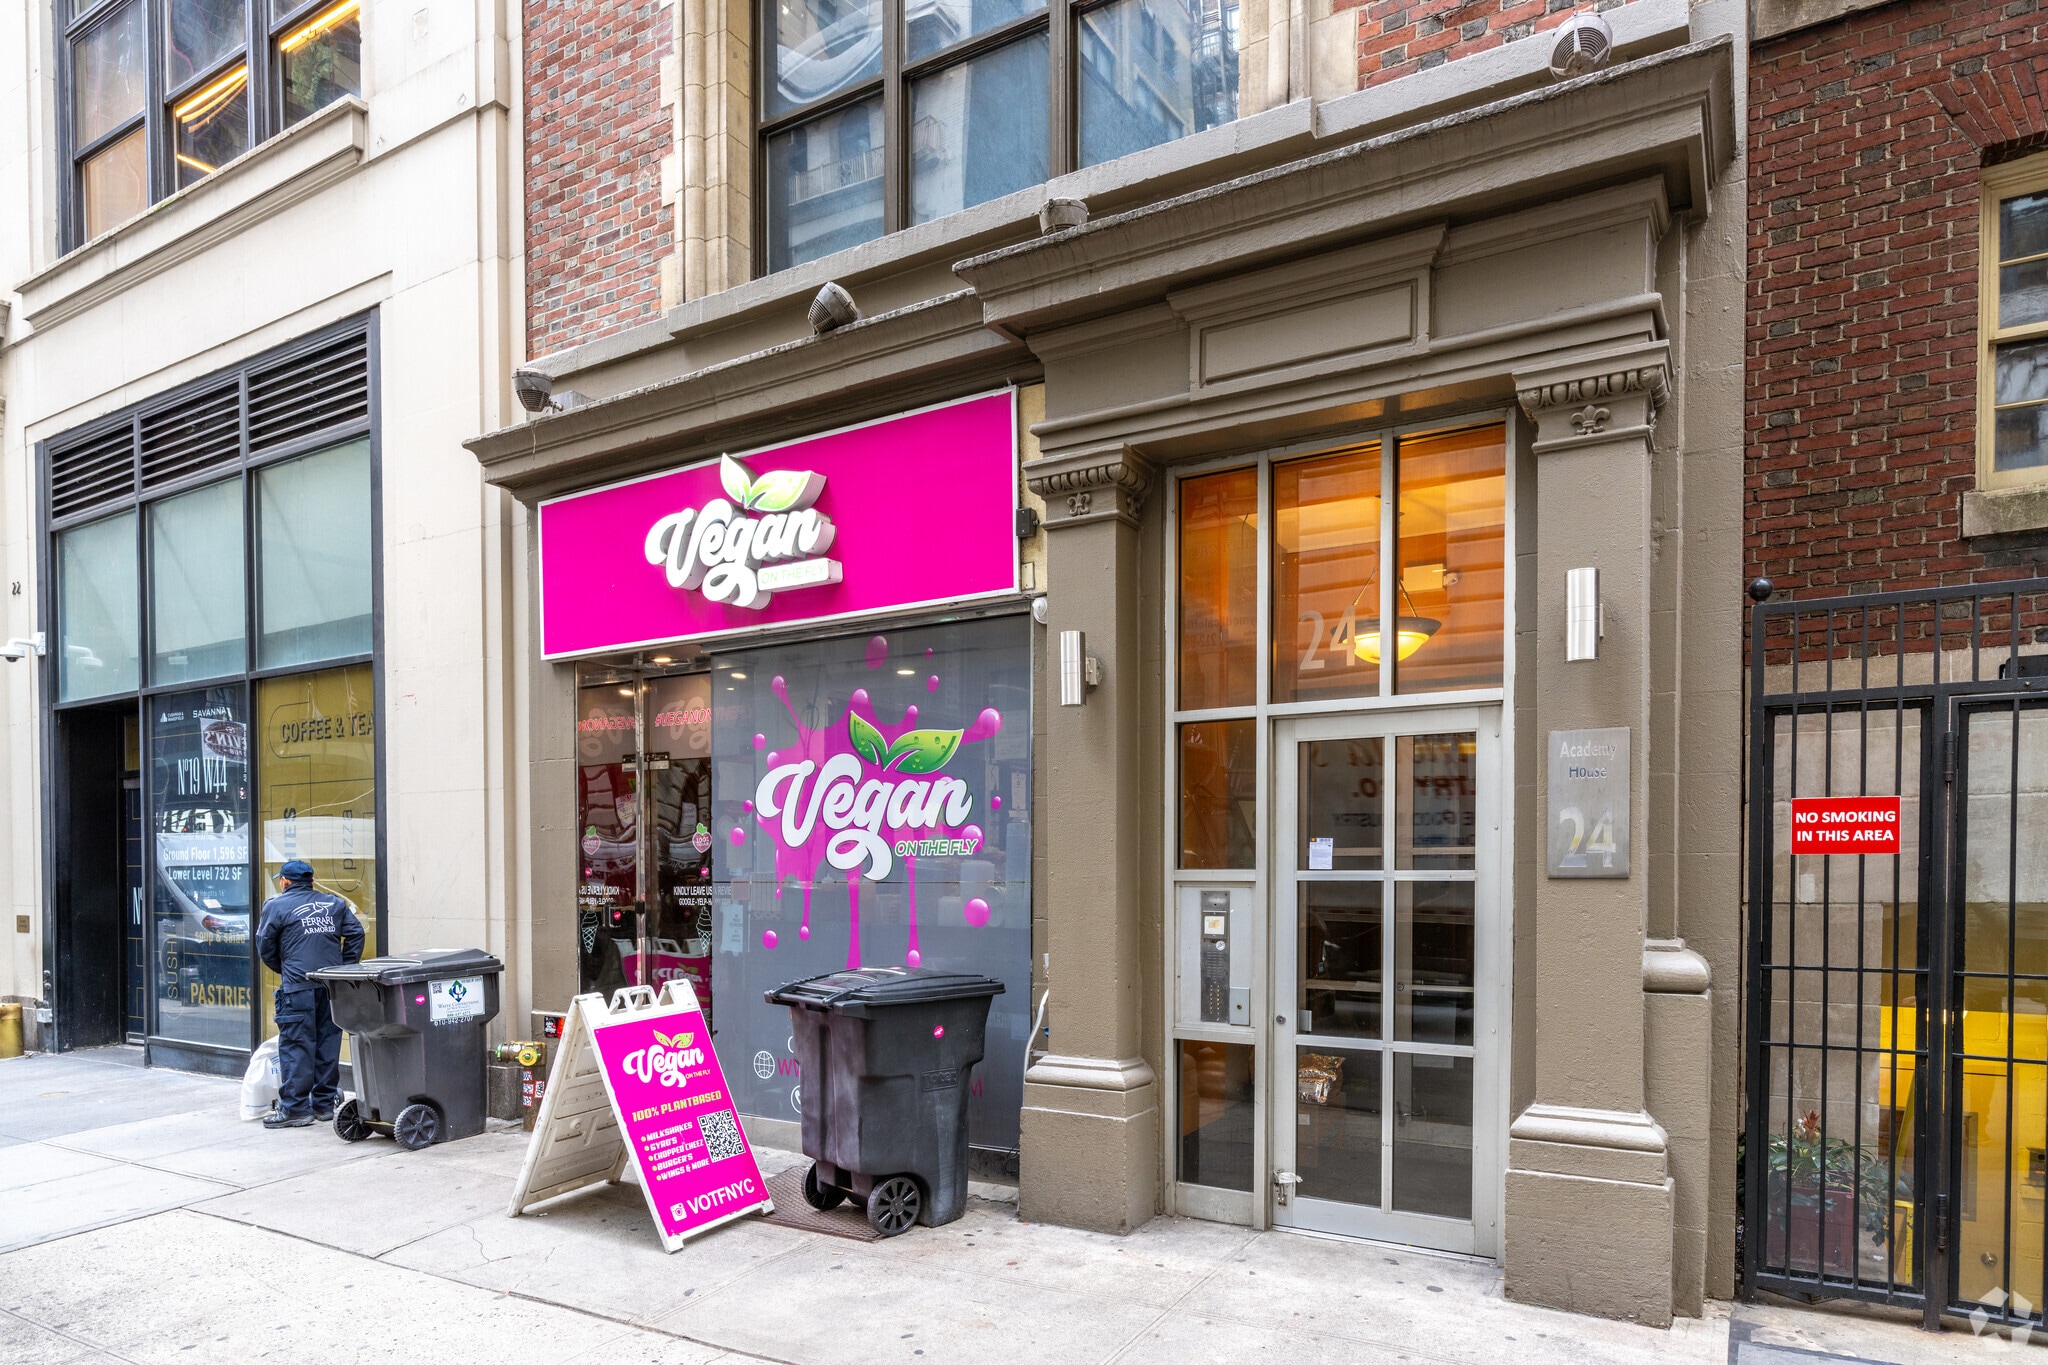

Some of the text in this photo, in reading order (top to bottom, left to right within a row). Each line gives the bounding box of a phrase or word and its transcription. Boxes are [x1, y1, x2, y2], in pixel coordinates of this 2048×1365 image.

[644, 498, 831, 608] Vegan
[761, 563, 825, 584] ON THE FLY
[1300, 605, 1356, 670] 24
[192, 706, 227, 718] SAVANNA
[281, 716, 332, 744] COFFEE
[335, 716, 345, 739] &
[1560, 740, 1617, 760] Academy
[203, 755, 227, 794] W44
[1569, 765, 1608, 779] House
[755, 753, 973, 881] Vegan
[1795, 810, 1896, 824] NO SMOKING
[342, 809, 357, 871] pizza
[1558, 805, 1617, 868] 24
[1796, 829, 1895, 842] IN THIS AREA
[163, 846, 248, 862] Ground Floor 1,596 SF
[895, 838, 978, 856] ON THE FLY
[168, 866, 242, 880] Lower Level 732 SF
[673, 886, 690, 895] KINDLY
[690, 886, 705, 895] LEAVE
[706, 886, 713, 895] US
[301, 916, 335, 927] FERRARI
[304, 926, 336, 934] ARMORED
[167, 933, 178, 999] SUSHI
[622, 1044, 704, 1088] Vegan
[685, 1072, 693, 1080] ON
[702, 1069, 711, 1077] FLY
[632, 1090, 722, 1122] 100% PLANTBASED
[646, 1122, 693, 1141] MILKSHAKES
[649, 1136, 678, 1151] GYRO'S
[653, 1139, 706, 1161] CHOPPED CHEEZ
[657, 1153, 694, 1171] BURGER'S
[661, 1158, 711, 1180] WINGS & MORE
[686, 1178, 755, 1214] VOTFNYC
